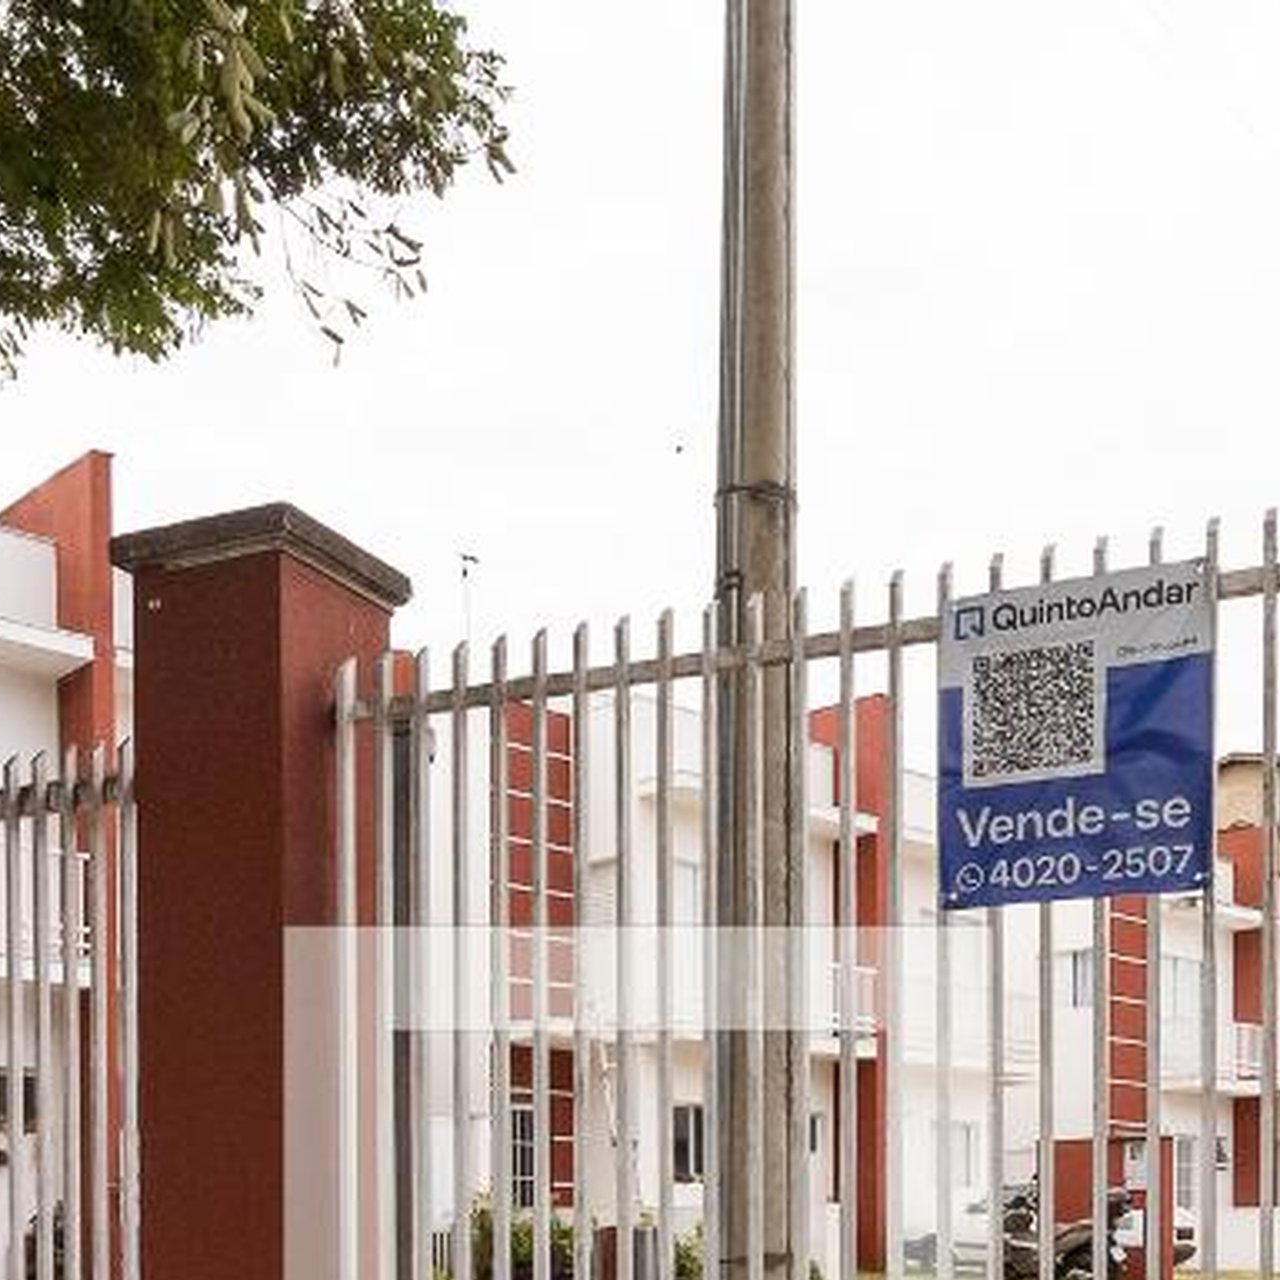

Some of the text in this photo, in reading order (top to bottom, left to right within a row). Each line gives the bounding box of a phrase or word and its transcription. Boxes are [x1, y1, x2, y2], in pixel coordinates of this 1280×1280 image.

[992, 580, 1199, 631] QuintoAndar
[956, 797, 1192, 847] Vende-se
[989, 845, 1194, 888] 4020-2507
